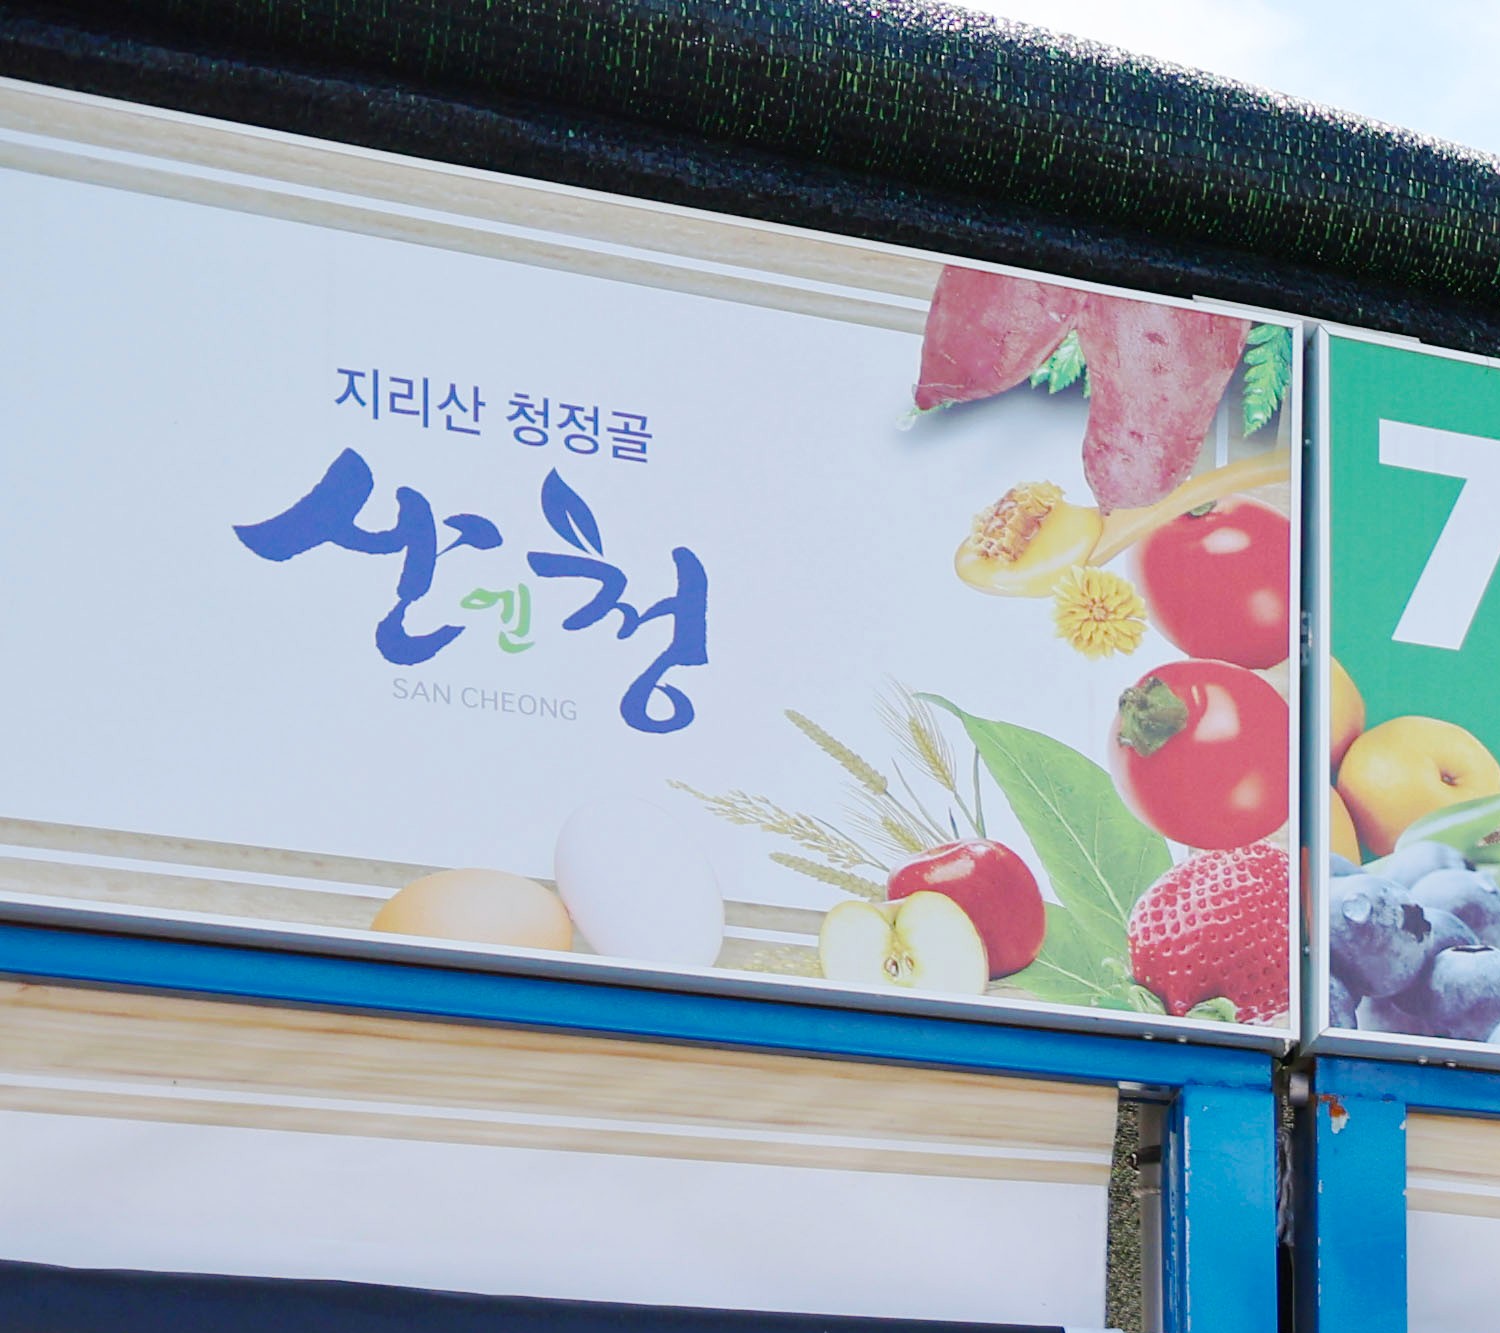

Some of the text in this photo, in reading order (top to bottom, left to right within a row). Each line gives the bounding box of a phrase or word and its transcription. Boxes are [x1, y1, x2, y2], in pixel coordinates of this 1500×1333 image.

[334, 363, 655, 465] 지리산 청정골
[391, 676, 579, 722] SAN CHEONG
